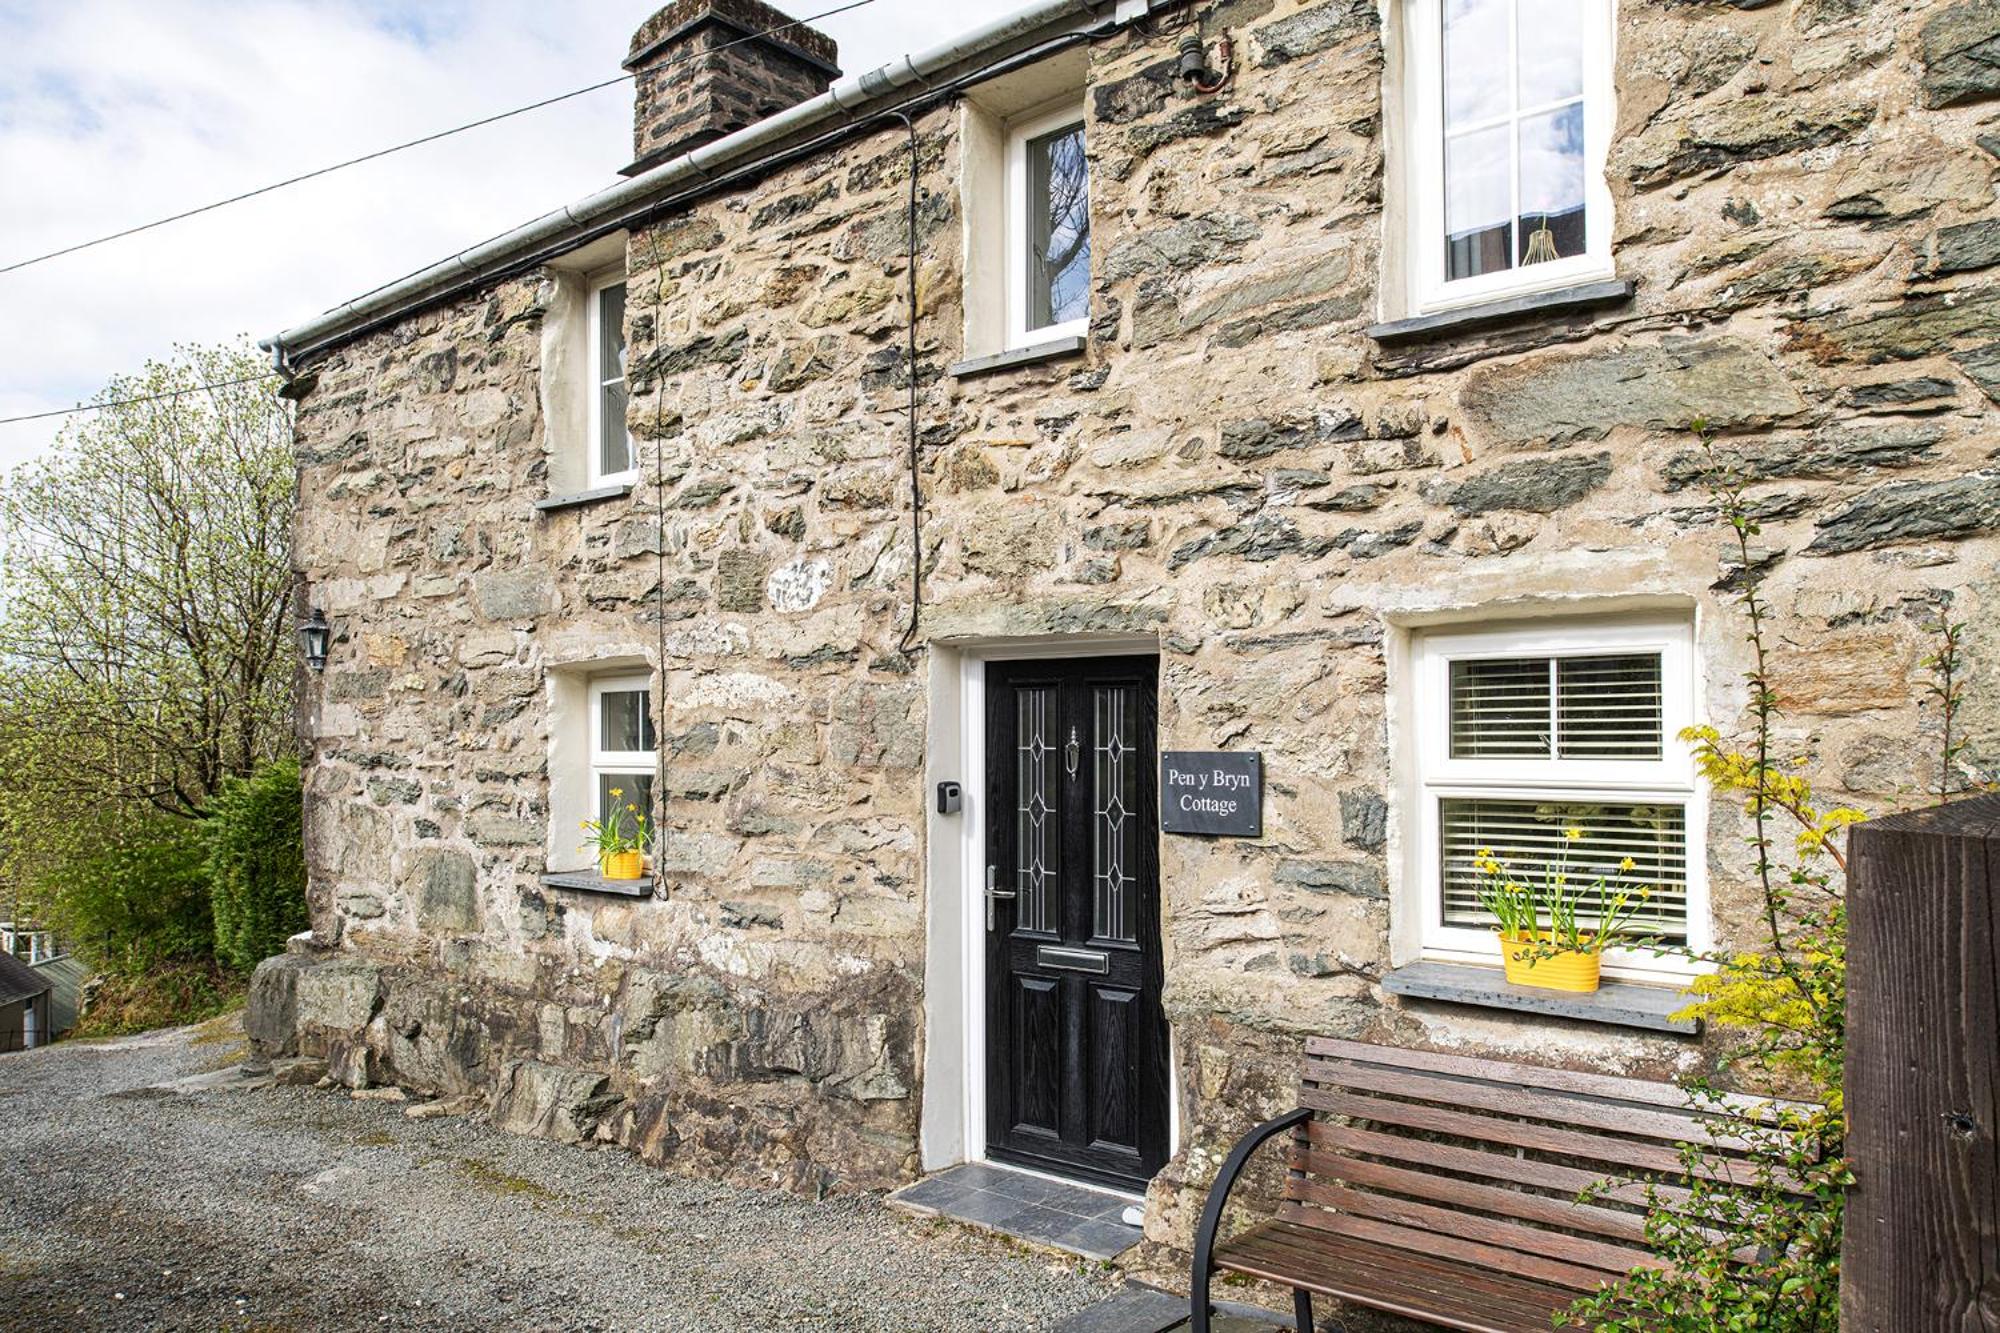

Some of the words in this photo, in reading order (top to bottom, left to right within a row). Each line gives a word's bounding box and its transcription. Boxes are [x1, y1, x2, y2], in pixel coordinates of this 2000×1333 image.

[1168, 769, 1195, 785] Pen
[1199, 773, 1209, 790] y
[1212, 769, 1250, 791] Bryn
[1180, 794, 1237, 816] Cottage
